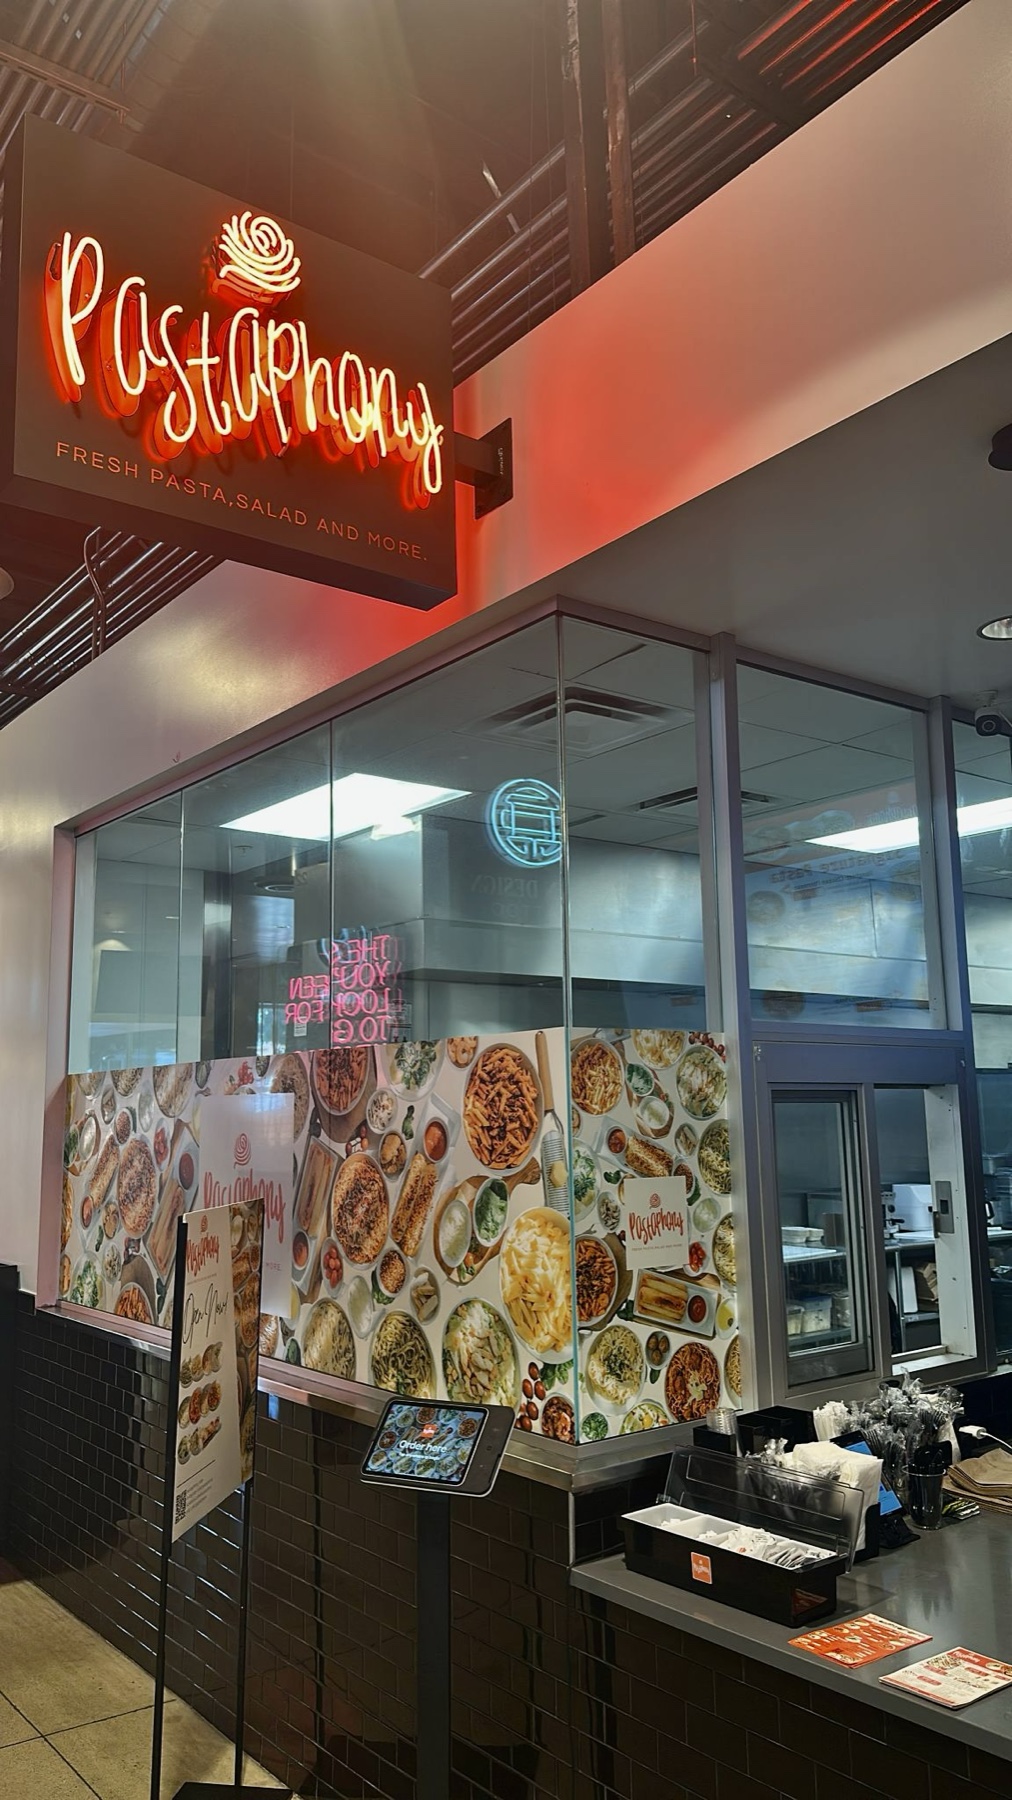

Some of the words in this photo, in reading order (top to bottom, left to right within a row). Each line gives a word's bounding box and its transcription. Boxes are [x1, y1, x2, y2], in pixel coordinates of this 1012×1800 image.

[60, 231, 444, 495] Pastaphony
[56, 441, 138, 479] FRESH
[317, 518, 359, 541] AND
[368, 531, 428, 561] MORE.
[628, 1207, 684, 1244] Pastaphony
[399, 1439, 425, 1451] Order
[425, 1442, 448, 1453] here
